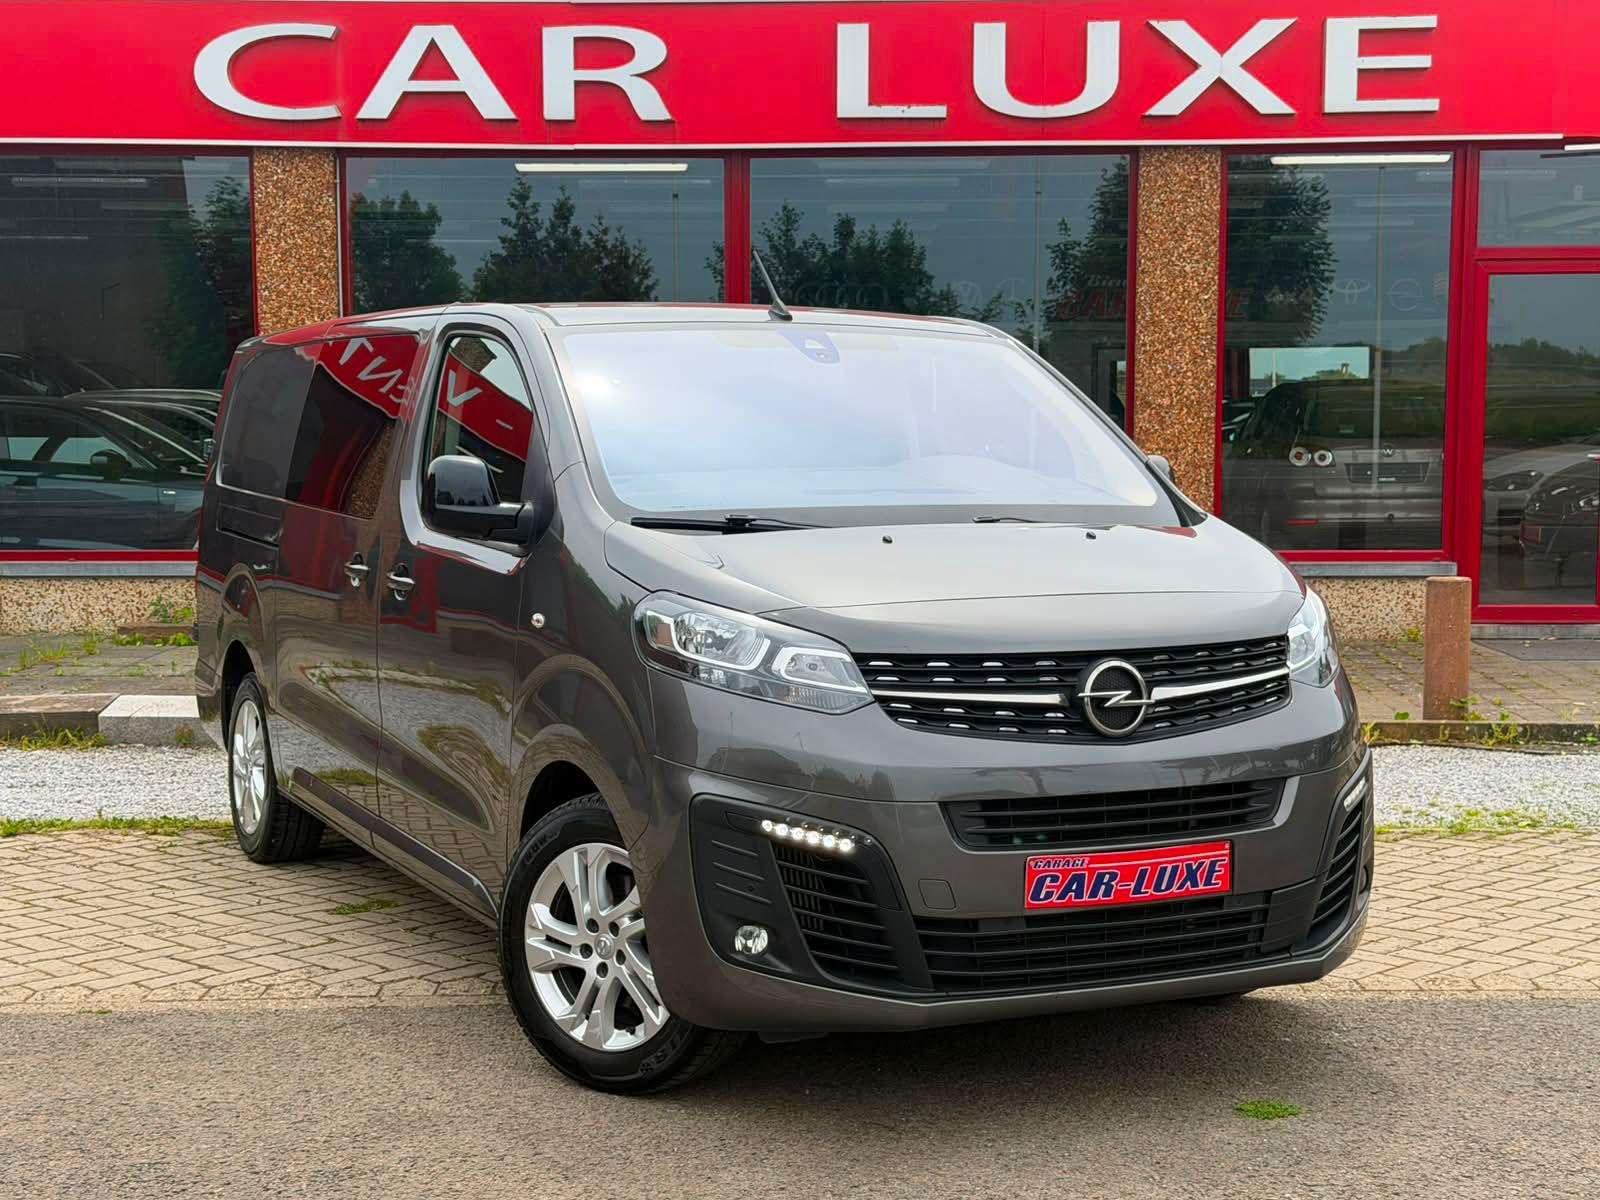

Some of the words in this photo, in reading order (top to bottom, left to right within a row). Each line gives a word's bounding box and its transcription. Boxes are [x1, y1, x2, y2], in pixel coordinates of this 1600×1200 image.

[193, 23, 675, 121] CAR
[836, 15, 1440, 119] LUXE
[1028, 856, 1228, 904] CAR-LUXE
[1031, 857, 1088, 870] GARAGE
